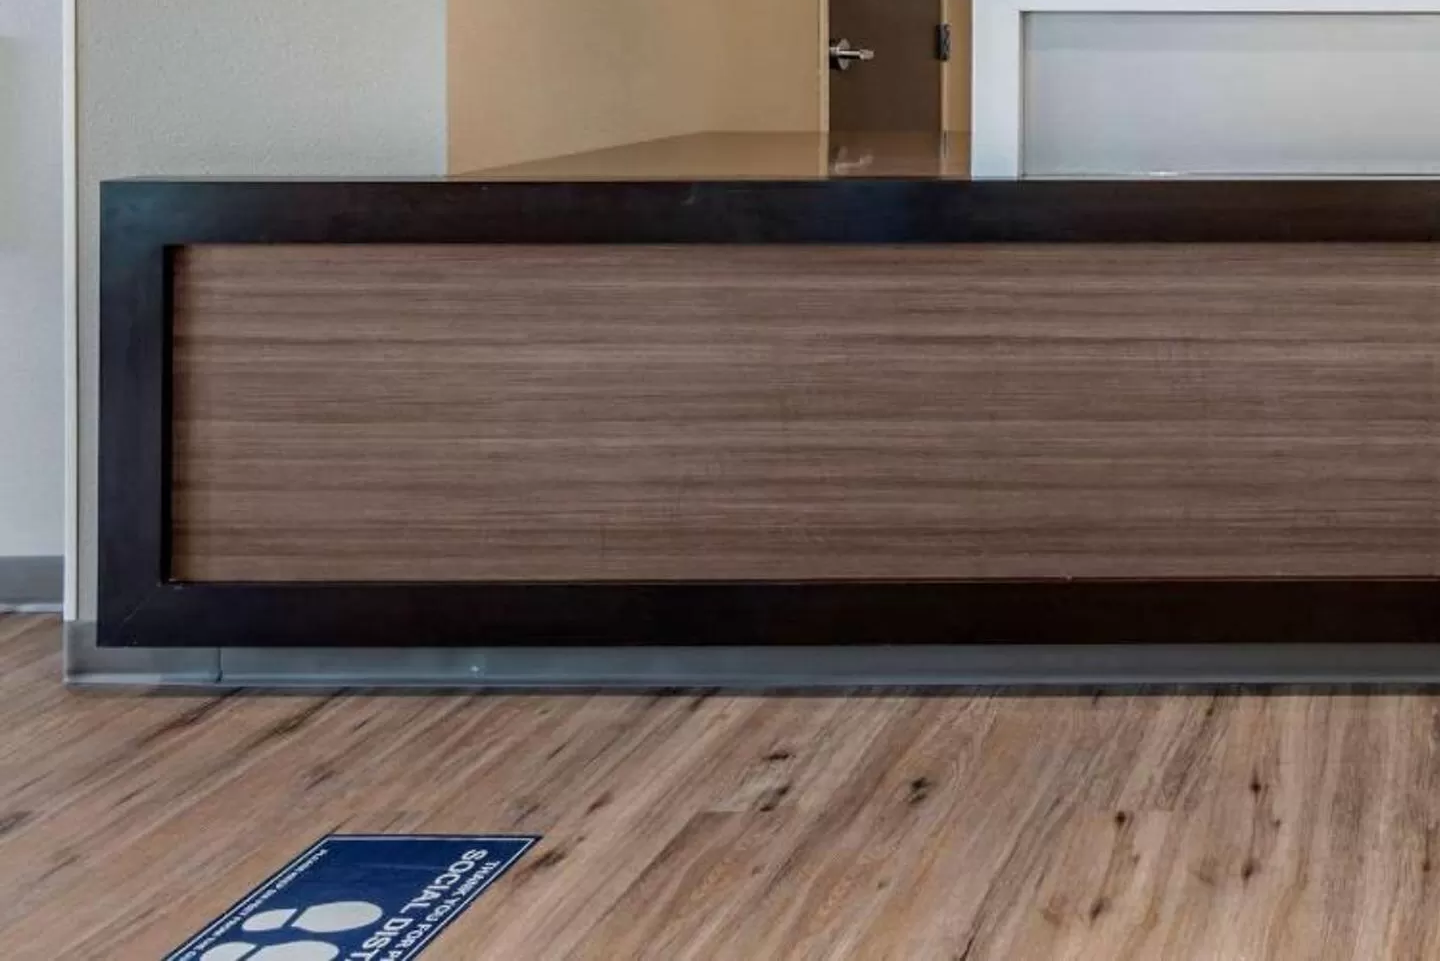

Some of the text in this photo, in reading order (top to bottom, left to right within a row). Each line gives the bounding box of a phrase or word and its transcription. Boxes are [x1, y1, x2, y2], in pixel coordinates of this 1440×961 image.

[345, 849, 489, 961] SOCIAL DIST
[394, 860, 501, 949] THANK YOU FOR
